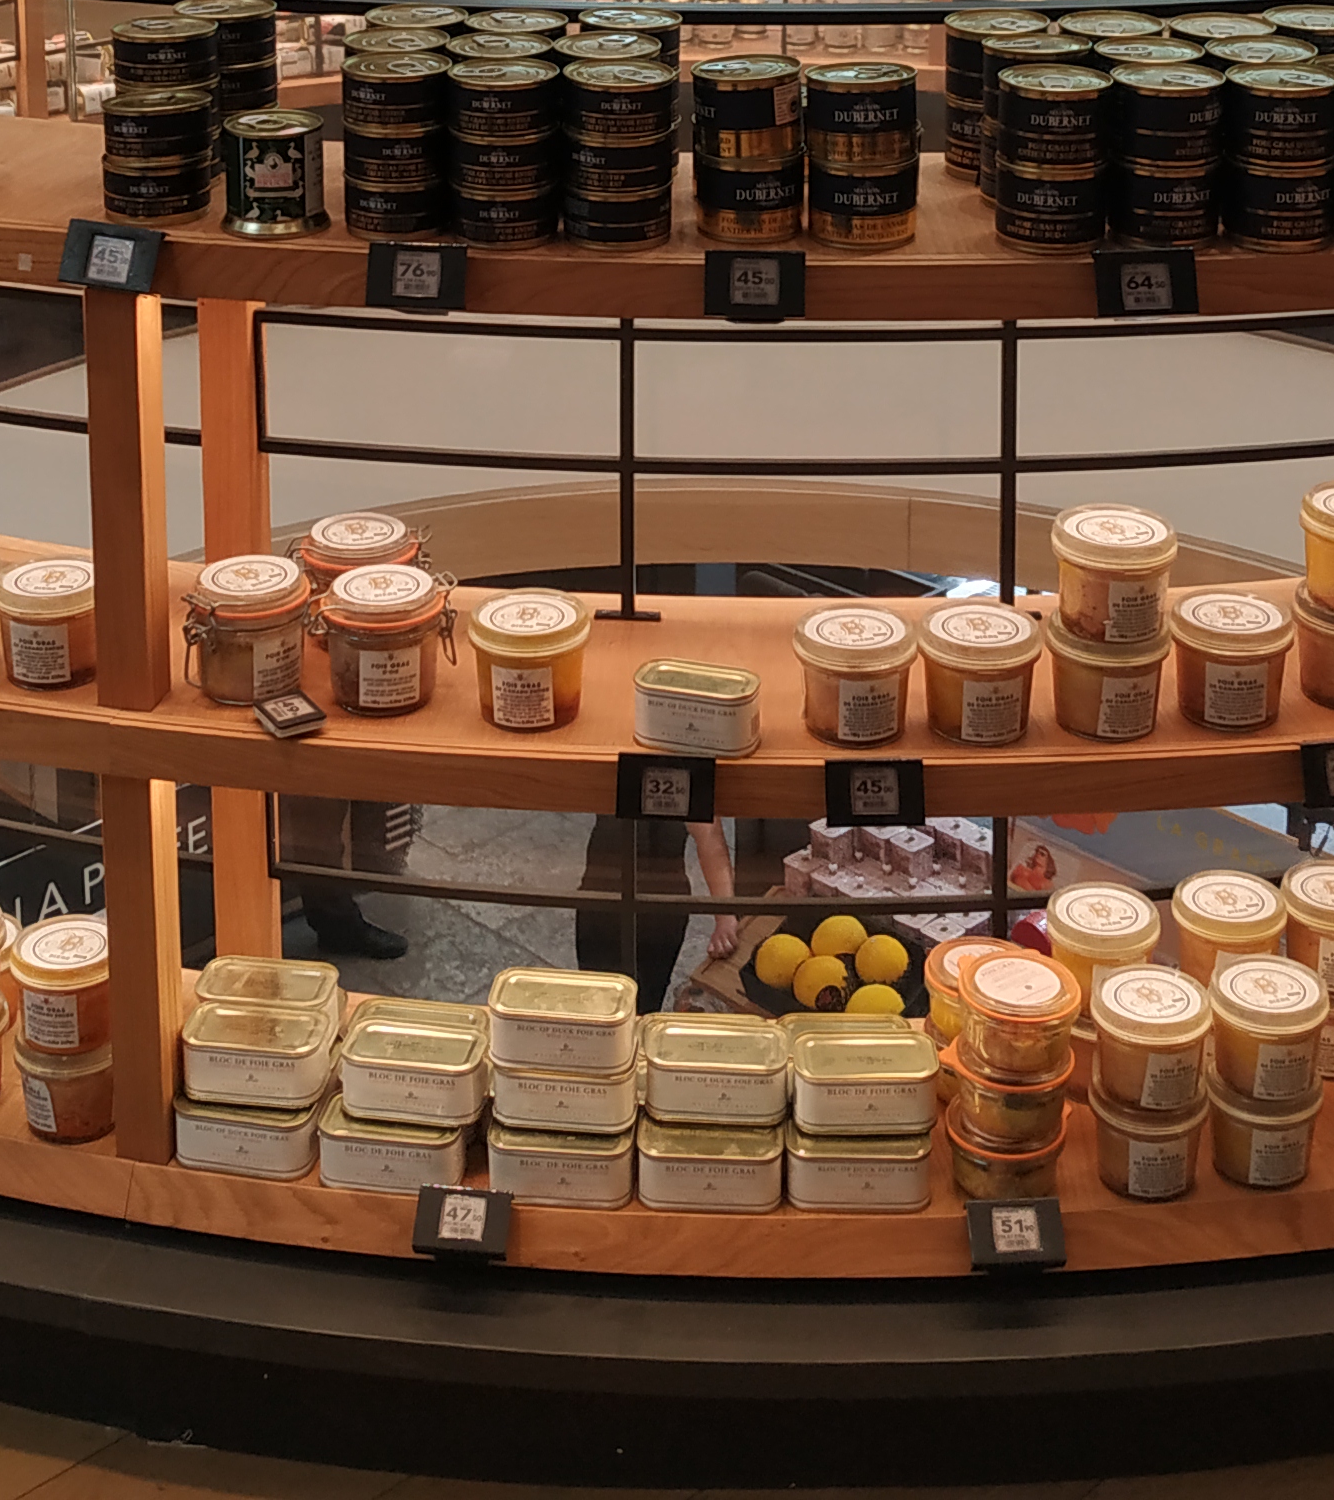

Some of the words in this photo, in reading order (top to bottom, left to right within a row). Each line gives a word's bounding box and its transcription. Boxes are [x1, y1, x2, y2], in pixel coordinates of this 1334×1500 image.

[834, 108, 899, 122] DUBERNET
[1030, 113, 1091, 127] DUBERNET
[1255, 110, 1317, 124] DUBERNET
[736, 185, 796, 201] DUBERNET
[834, 191, 899, 205] DUBERNET
[1017, 192, 1078, 206] DUBERNET
[1154, 191, 1211, 206] DUBERNET
[1276, 188, 1331, 203] DUBERNET
[95, 247, 118, 264] 45
[398, 262, 425, 277] 76
[736, 271, 763, 285] 45
[1126, 275, 1154, 289] 64
[390, 660, 410, 669] GRAS
[502, 681, 518, 689] FOIE
[871, 692, 890, 700] GRAS
[994, 694, 1014, 702] GRAS
[649, 779, 674, 794] 32
[856, 780, 883, 794] 45
[209, 1055, 232, 1064] BLOC
[249, 1059, 270, 1067] FOIE
[272, 1060, 296, 1069] GRAS
[368, 1071, 392, 1081] BLOC
[394, 1074, 407, 1082] DE
[409, 1075, 430, 1085] FOIE
[433, 1077, 456, 1087] GRAS
[517, 1081, 542, 1091] BLOC
[544, 1084, 557, 1092] DE
[559, 1084, 581, 1094] FOIE
[583, 1086, 607, 1095] GRAS
[827, 1087, 851, 1096] BLOC
[854, 1087, 867, 1096] DE
[869, 1087, 891, 1096] FOIE
[893, 1086, 917, 1095] GRAS
[344, 1144, 368, 1154] BLOC
[370, 1147, 383, 1156] DE
[385, 1149, 406, 1158] FOIE
[408, 1150, 432, 1160] GRAS
[519, 1158, 543, 1168] BLOC
[546, 1161, 558, 1169] DE
[560, 1161, 583, 1170] FOIE
[585, 1161, 609, 1171] GRAS
[665, 1165, 690, 1173] BLOC
[692, 1166, 705, 1174] DE
[707, 1166, 729, 1175] FOIE
[732, 1167, 756, 1176] GRAS
[446, 1207, 472, 1221] 47
[1001, 1219, 1024, 1233] 51
